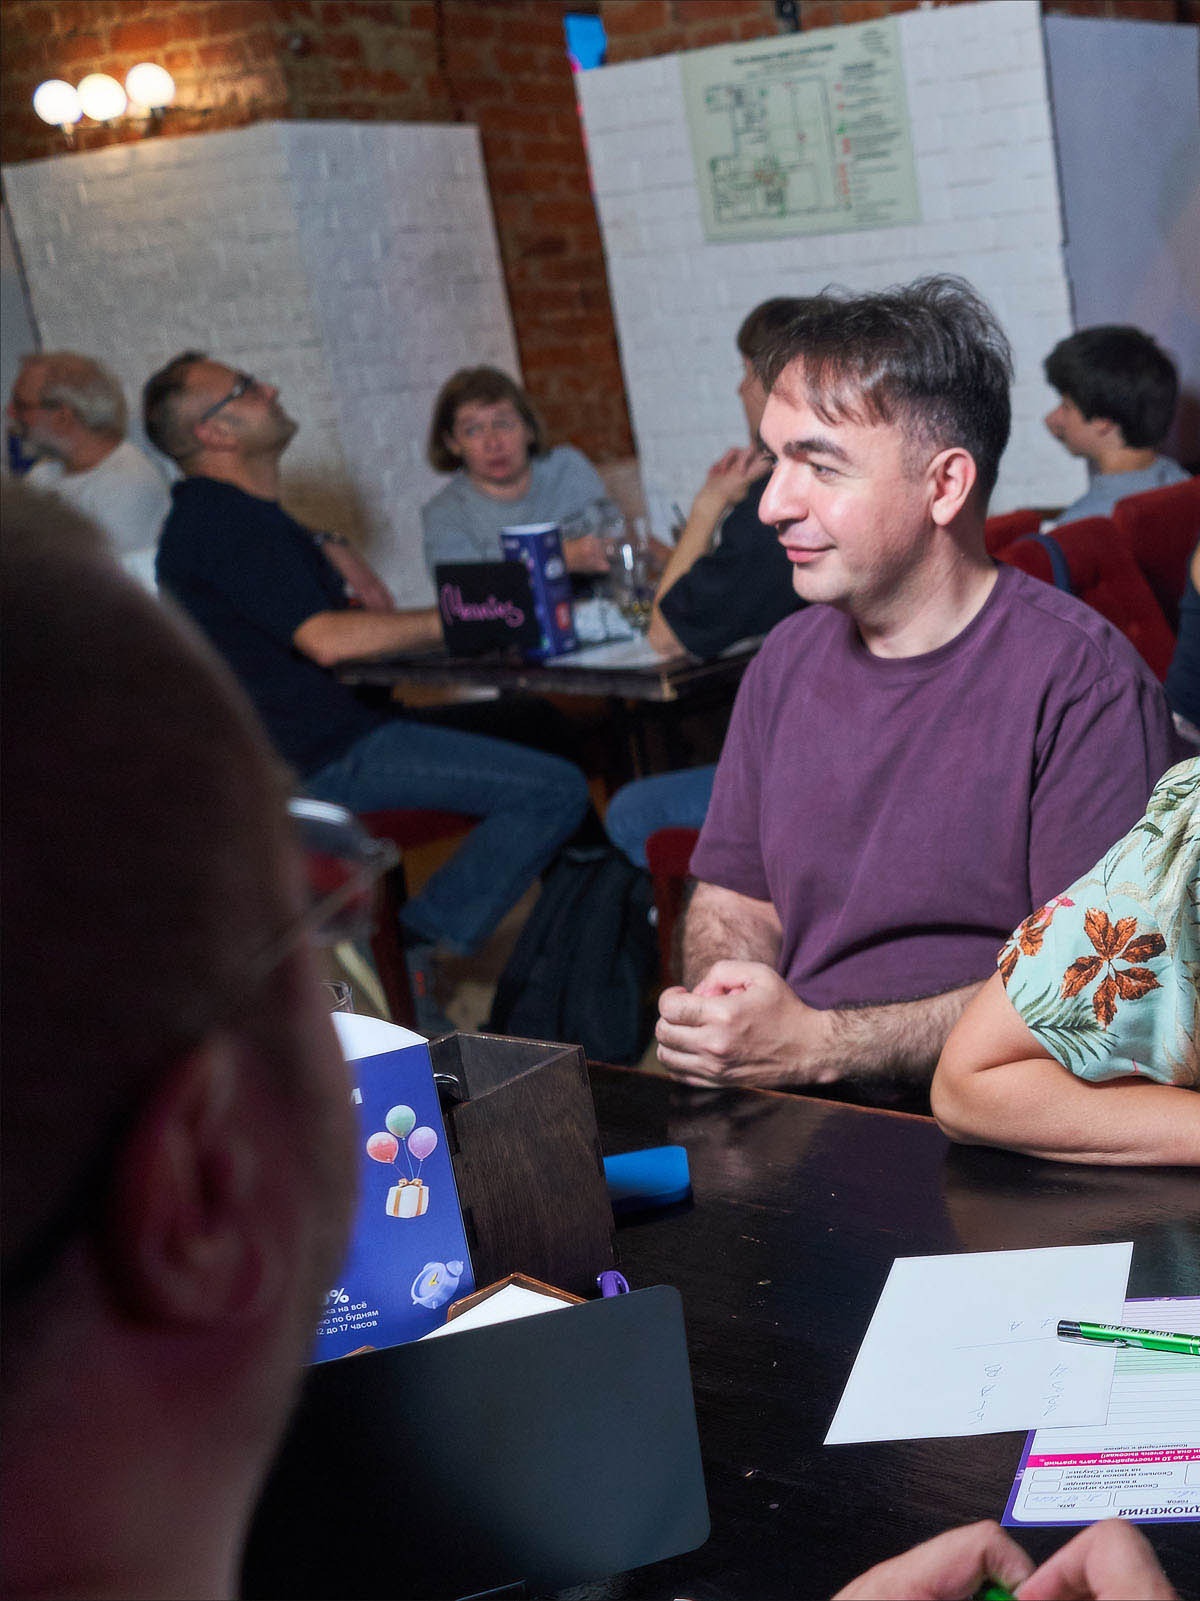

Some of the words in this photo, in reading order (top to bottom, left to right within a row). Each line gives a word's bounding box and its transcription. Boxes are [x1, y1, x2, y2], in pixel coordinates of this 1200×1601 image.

[337, 1305, 349, 1313] на
[350, 1301, 368, 1311] всё
[332, 1316, 344, 1324] по
[345, 1310, 379, 1322] будням
[326, 1326, 338, 1335] до
[339, 1323, 349, 1331] 17
[350, 1320, 378, 1330] часов
